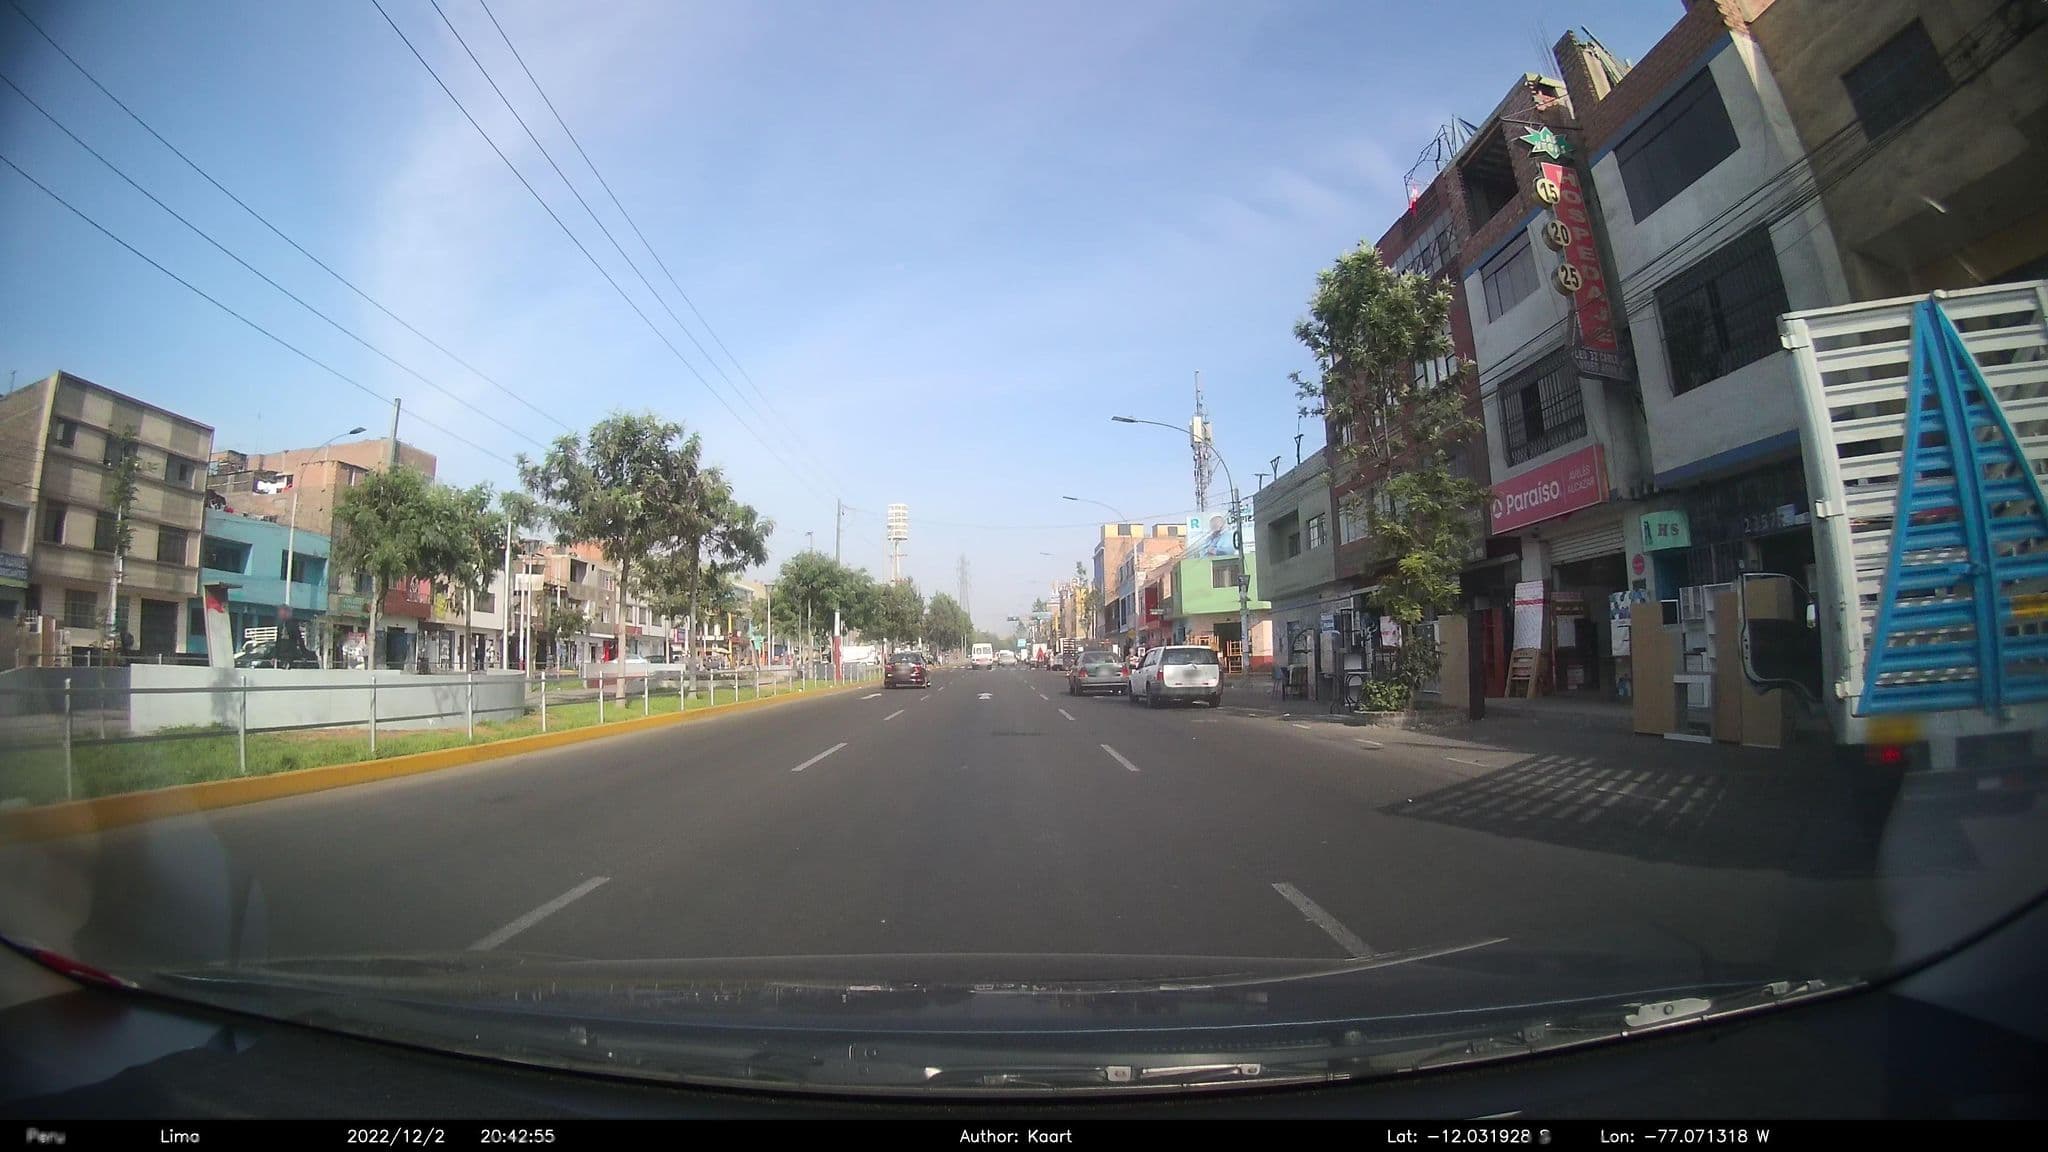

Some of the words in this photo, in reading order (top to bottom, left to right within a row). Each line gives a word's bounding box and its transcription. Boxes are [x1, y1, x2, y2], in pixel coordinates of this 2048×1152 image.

[1540, 182, 1558, 201] 15
[1551, 222, 1569, 245] 20
[1557, 169, 1614, 344] HOSPEDAJE
[1561, 264, 1580, 288] 25
